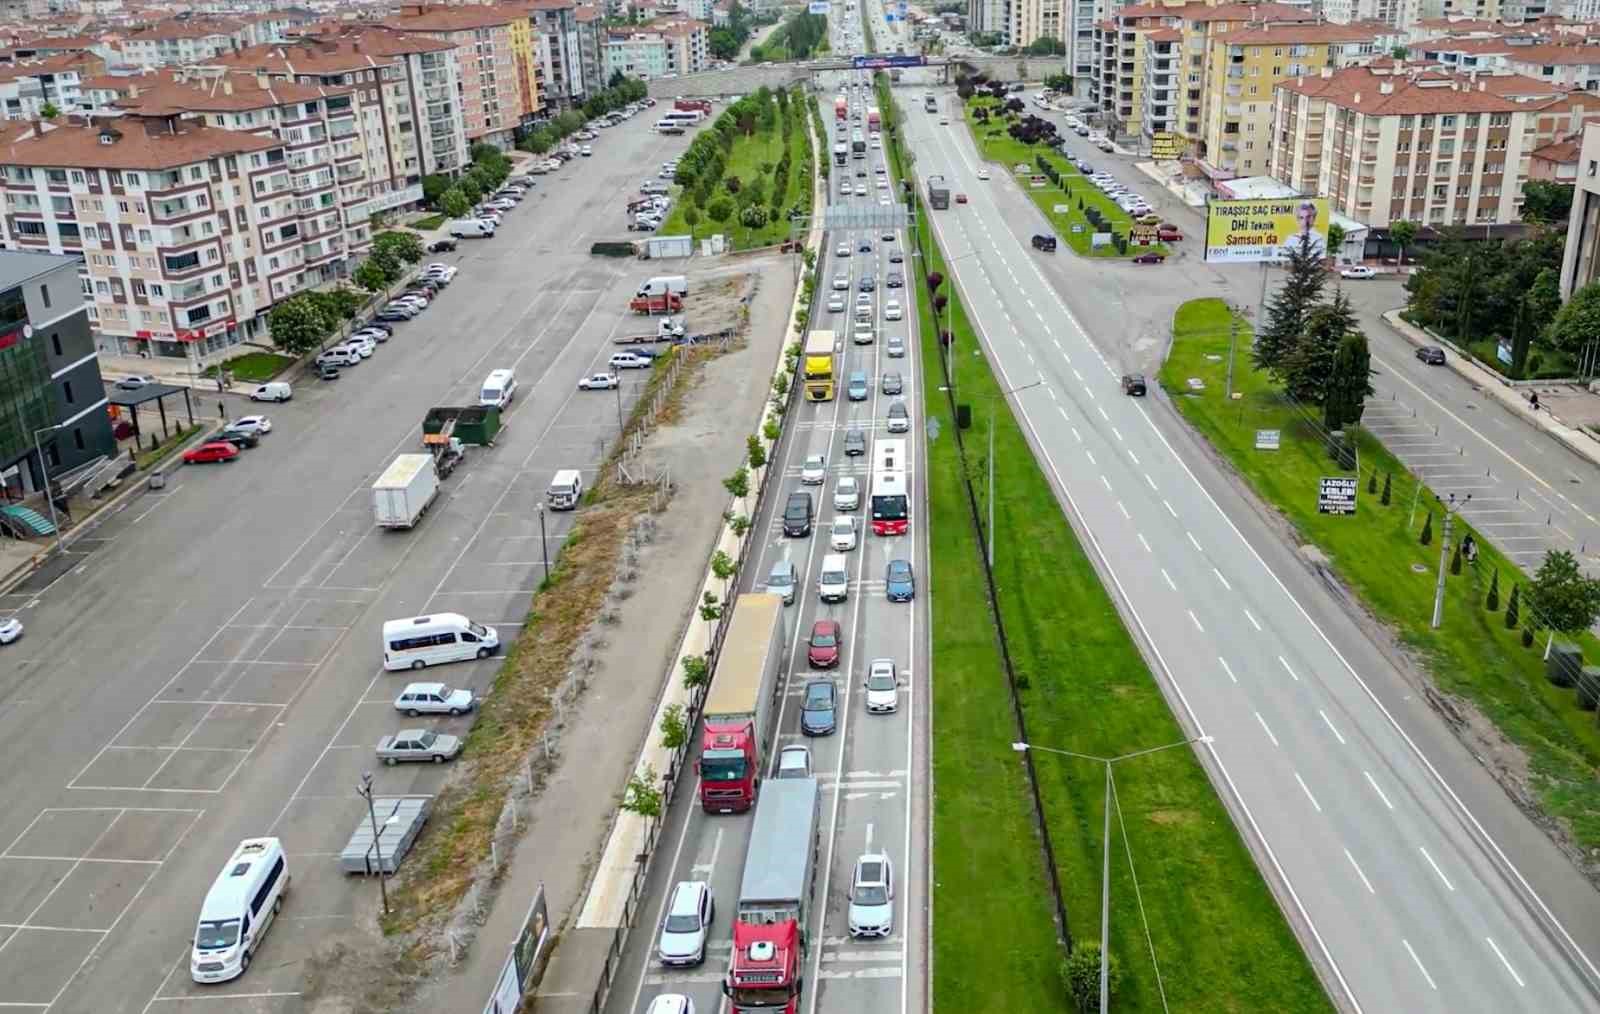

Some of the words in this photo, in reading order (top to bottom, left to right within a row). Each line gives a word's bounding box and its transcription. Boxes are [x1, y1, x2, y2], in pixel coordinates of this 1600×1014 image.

[1252, 206, 1269, 216] SAÇ
[1250, 221, 1274, 231] Teknik
[1226, 232, 1278, 245] Samsun'da
